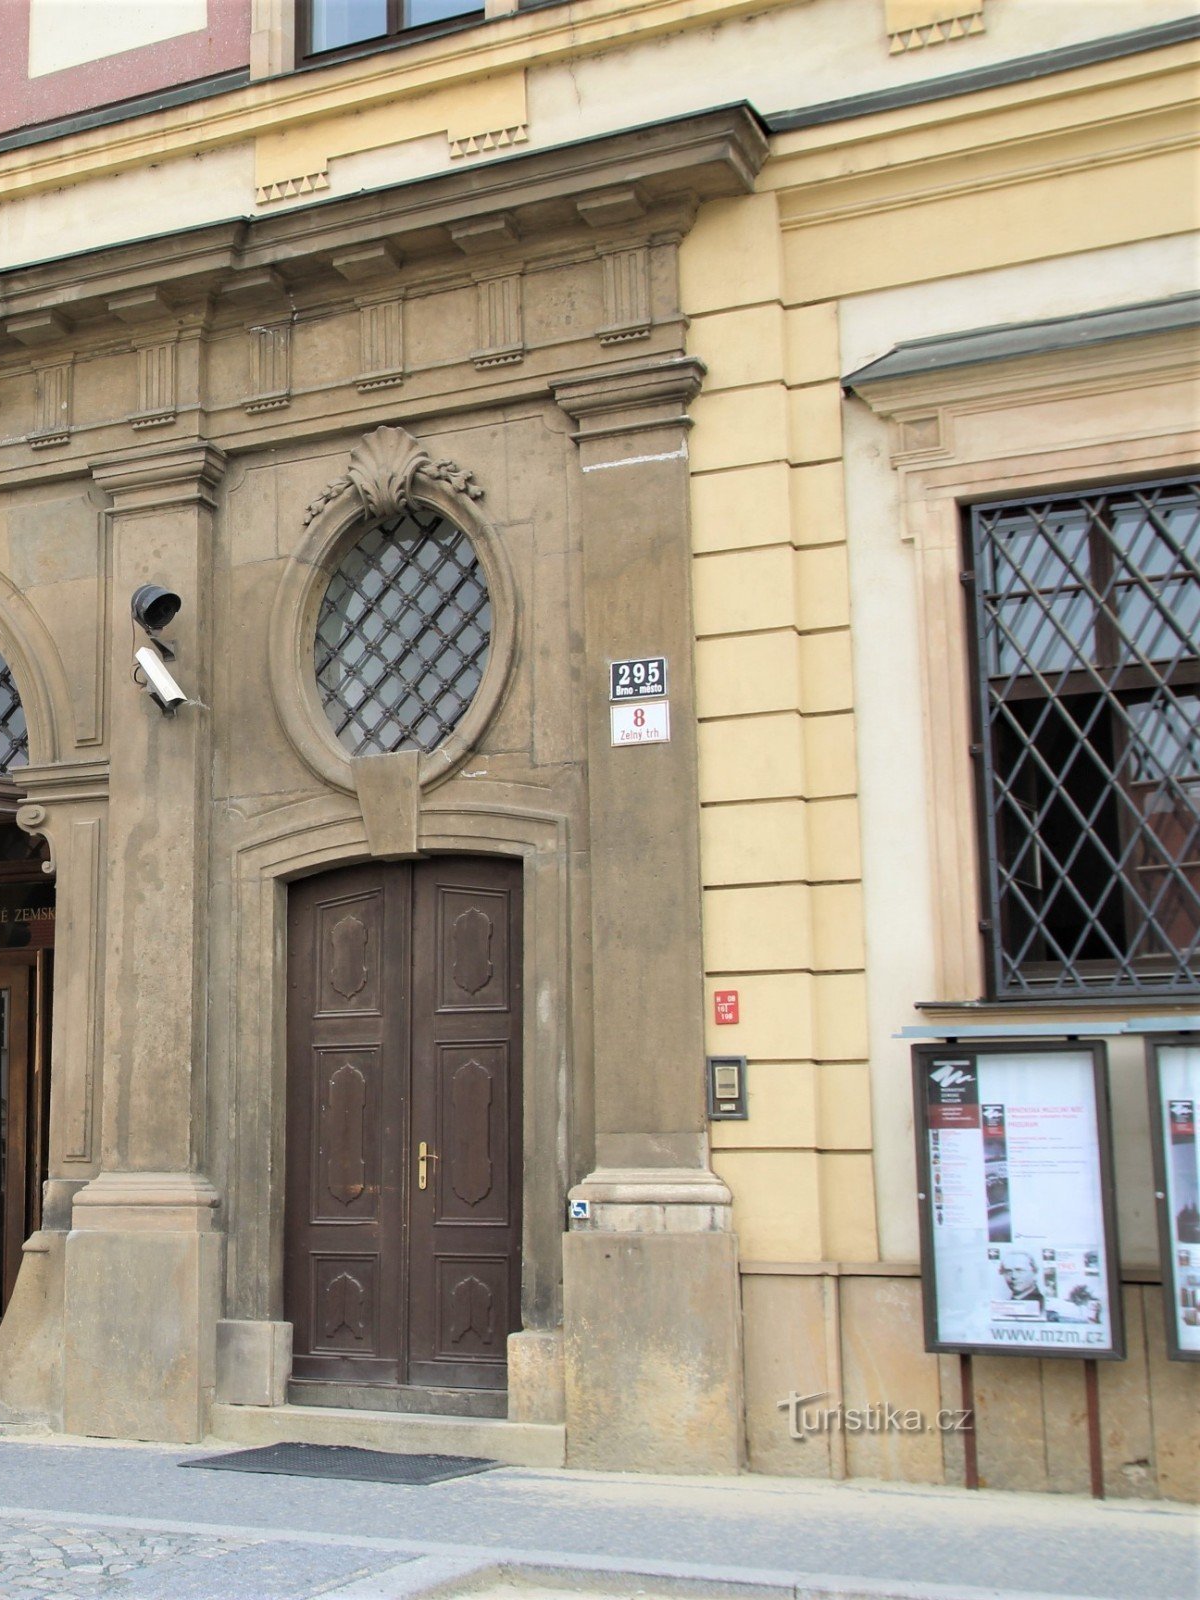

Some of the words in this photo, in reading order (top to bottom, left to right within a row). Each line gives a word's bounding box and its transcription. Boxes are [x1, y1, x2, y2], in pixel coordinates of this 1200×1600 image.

[618, 661, 660, 686] 295
[616, 685, 634, 696] Brno
[639, 682, 663, 694] město
[633, 708, 645, 727] 8
[620, 729, 643, 741] Zelný
[646, 728, 659, 738] trh
[990, 1328, 1105, 1344] www.mzm.cz
